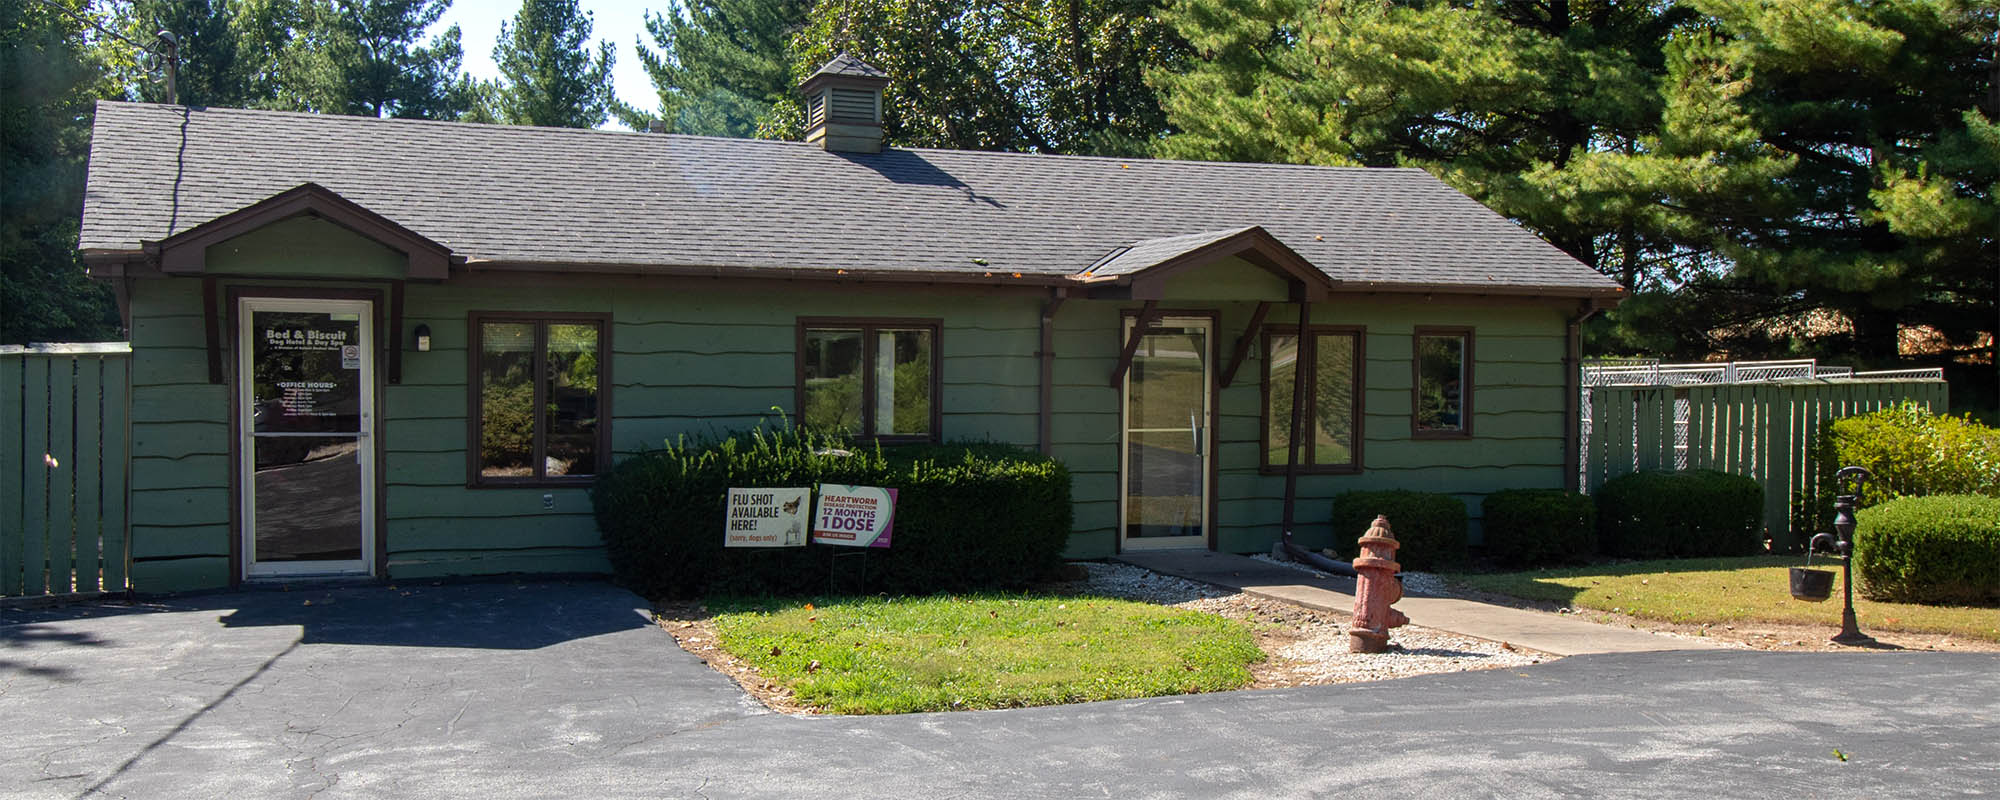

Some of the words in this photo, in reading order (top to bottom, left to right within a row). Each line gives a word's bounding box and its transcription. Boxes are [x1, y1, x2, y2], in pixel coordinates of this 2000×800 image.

[266, 329, 290, 339] Bed
[294, 330, 304, 339] &
[307, 330, 347, 340] Biscuit
[733, 494, 749, 505] FLU
[751, 494, 774, 505] SHOT
[824, 495, 878, 505] HEARTWORM
[731, 507, 779, 518] AVAILABLE
[823, 508, 832, 516] 12
[834, 508, 876, 519] MONTHS
[731, 520, 758, 531] HERE!
[822, 516, 829, 529] 1
[831, 516, 875, 531] DOSE
[729, 534, 748, 542] (sorry,
[749, 534, 762, 542] dogs
[762, 534, 777, 542] only)
